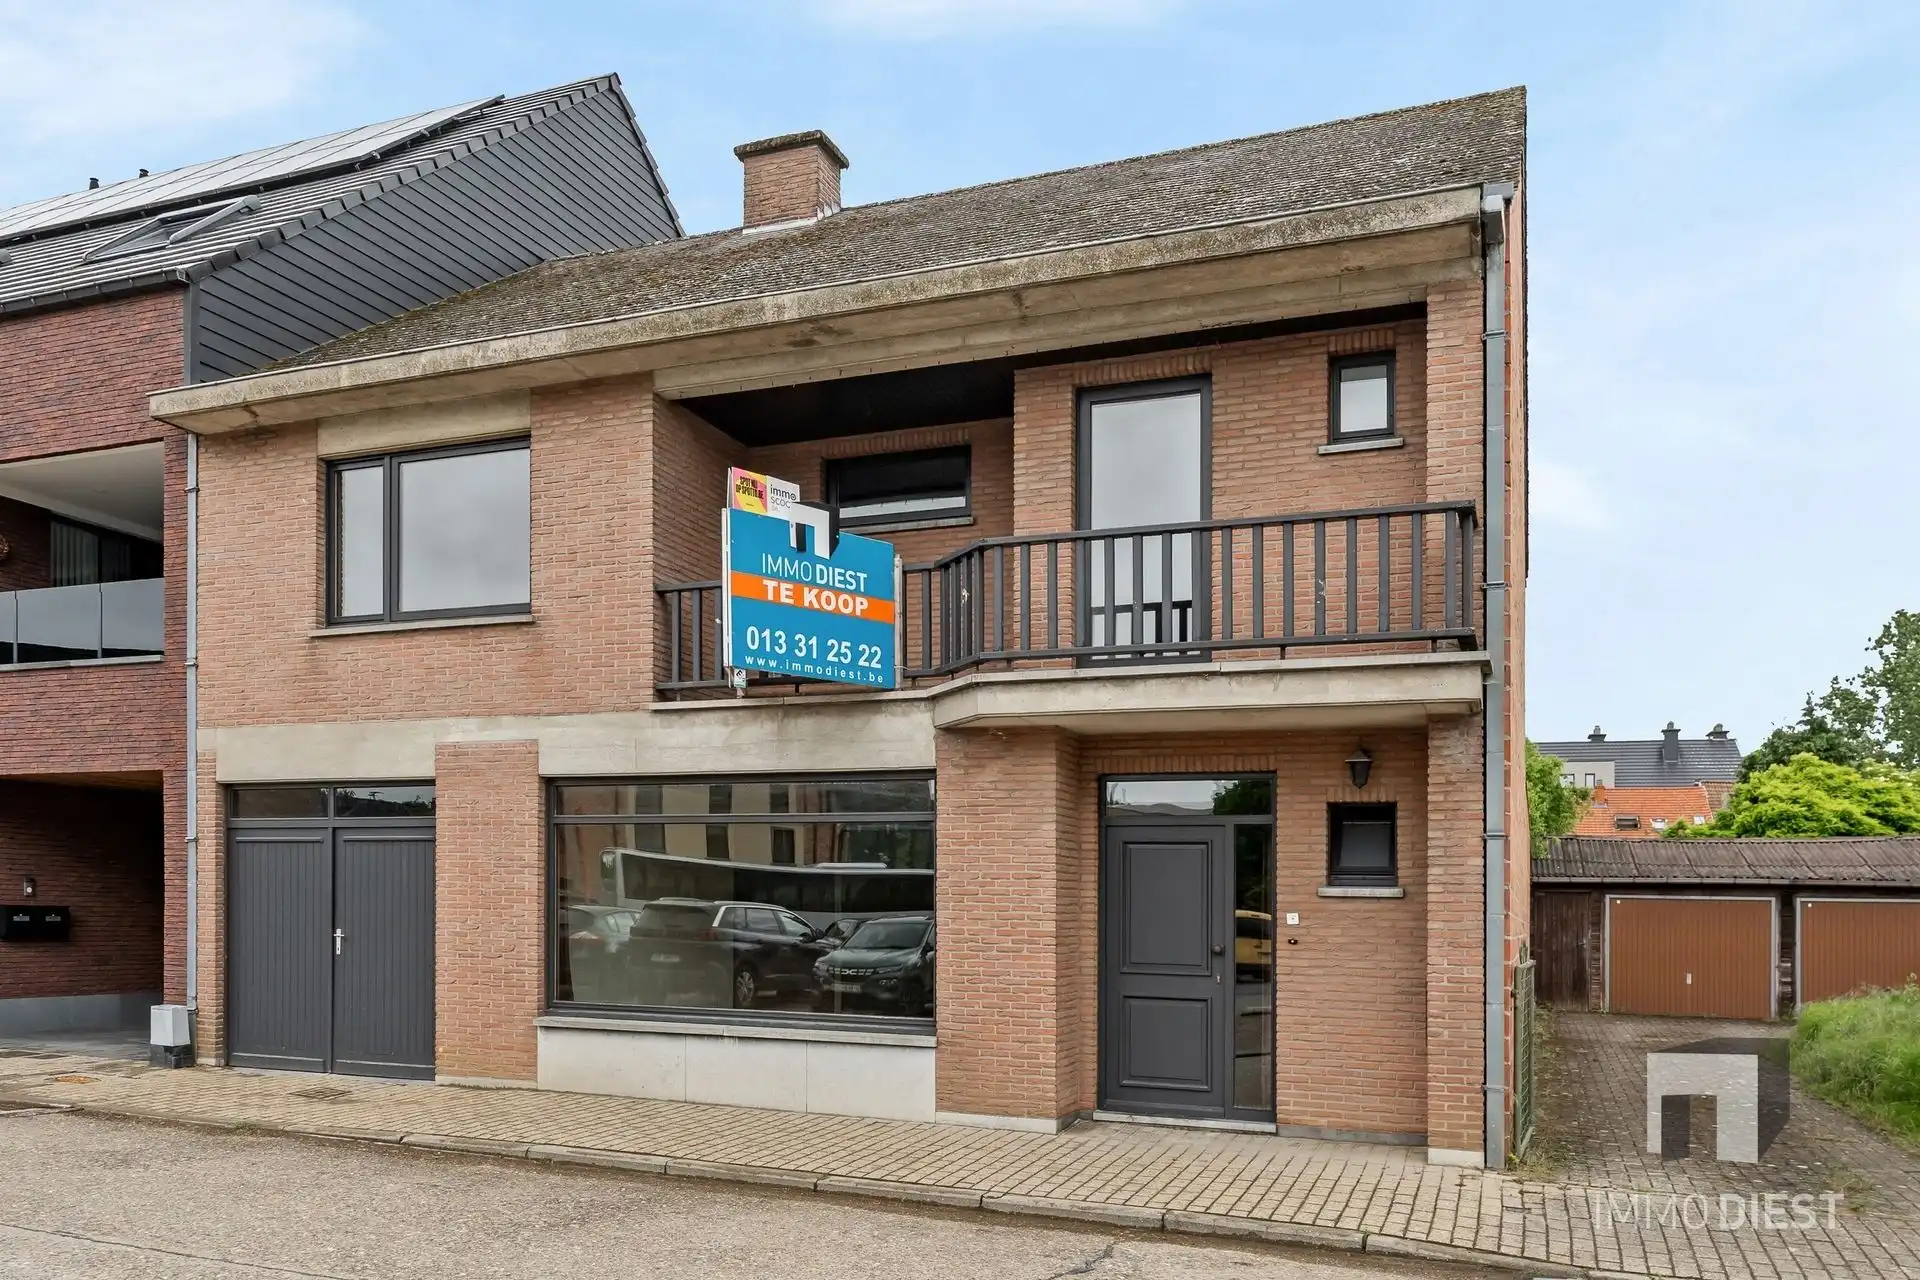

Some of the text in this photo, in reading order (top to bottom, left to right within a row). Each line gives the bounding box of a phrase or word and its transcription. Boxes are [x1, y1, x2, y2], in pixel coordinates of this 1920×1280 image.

[770, 484, 796, 500] immo
[762, 553, 868, 593] IMMO DIEST
[762, 579, 869, 617] TE KOOP
[746, 625, 882, 669] 013 31 25 22
[745, 655, 883, 683] www.immodiest.be
